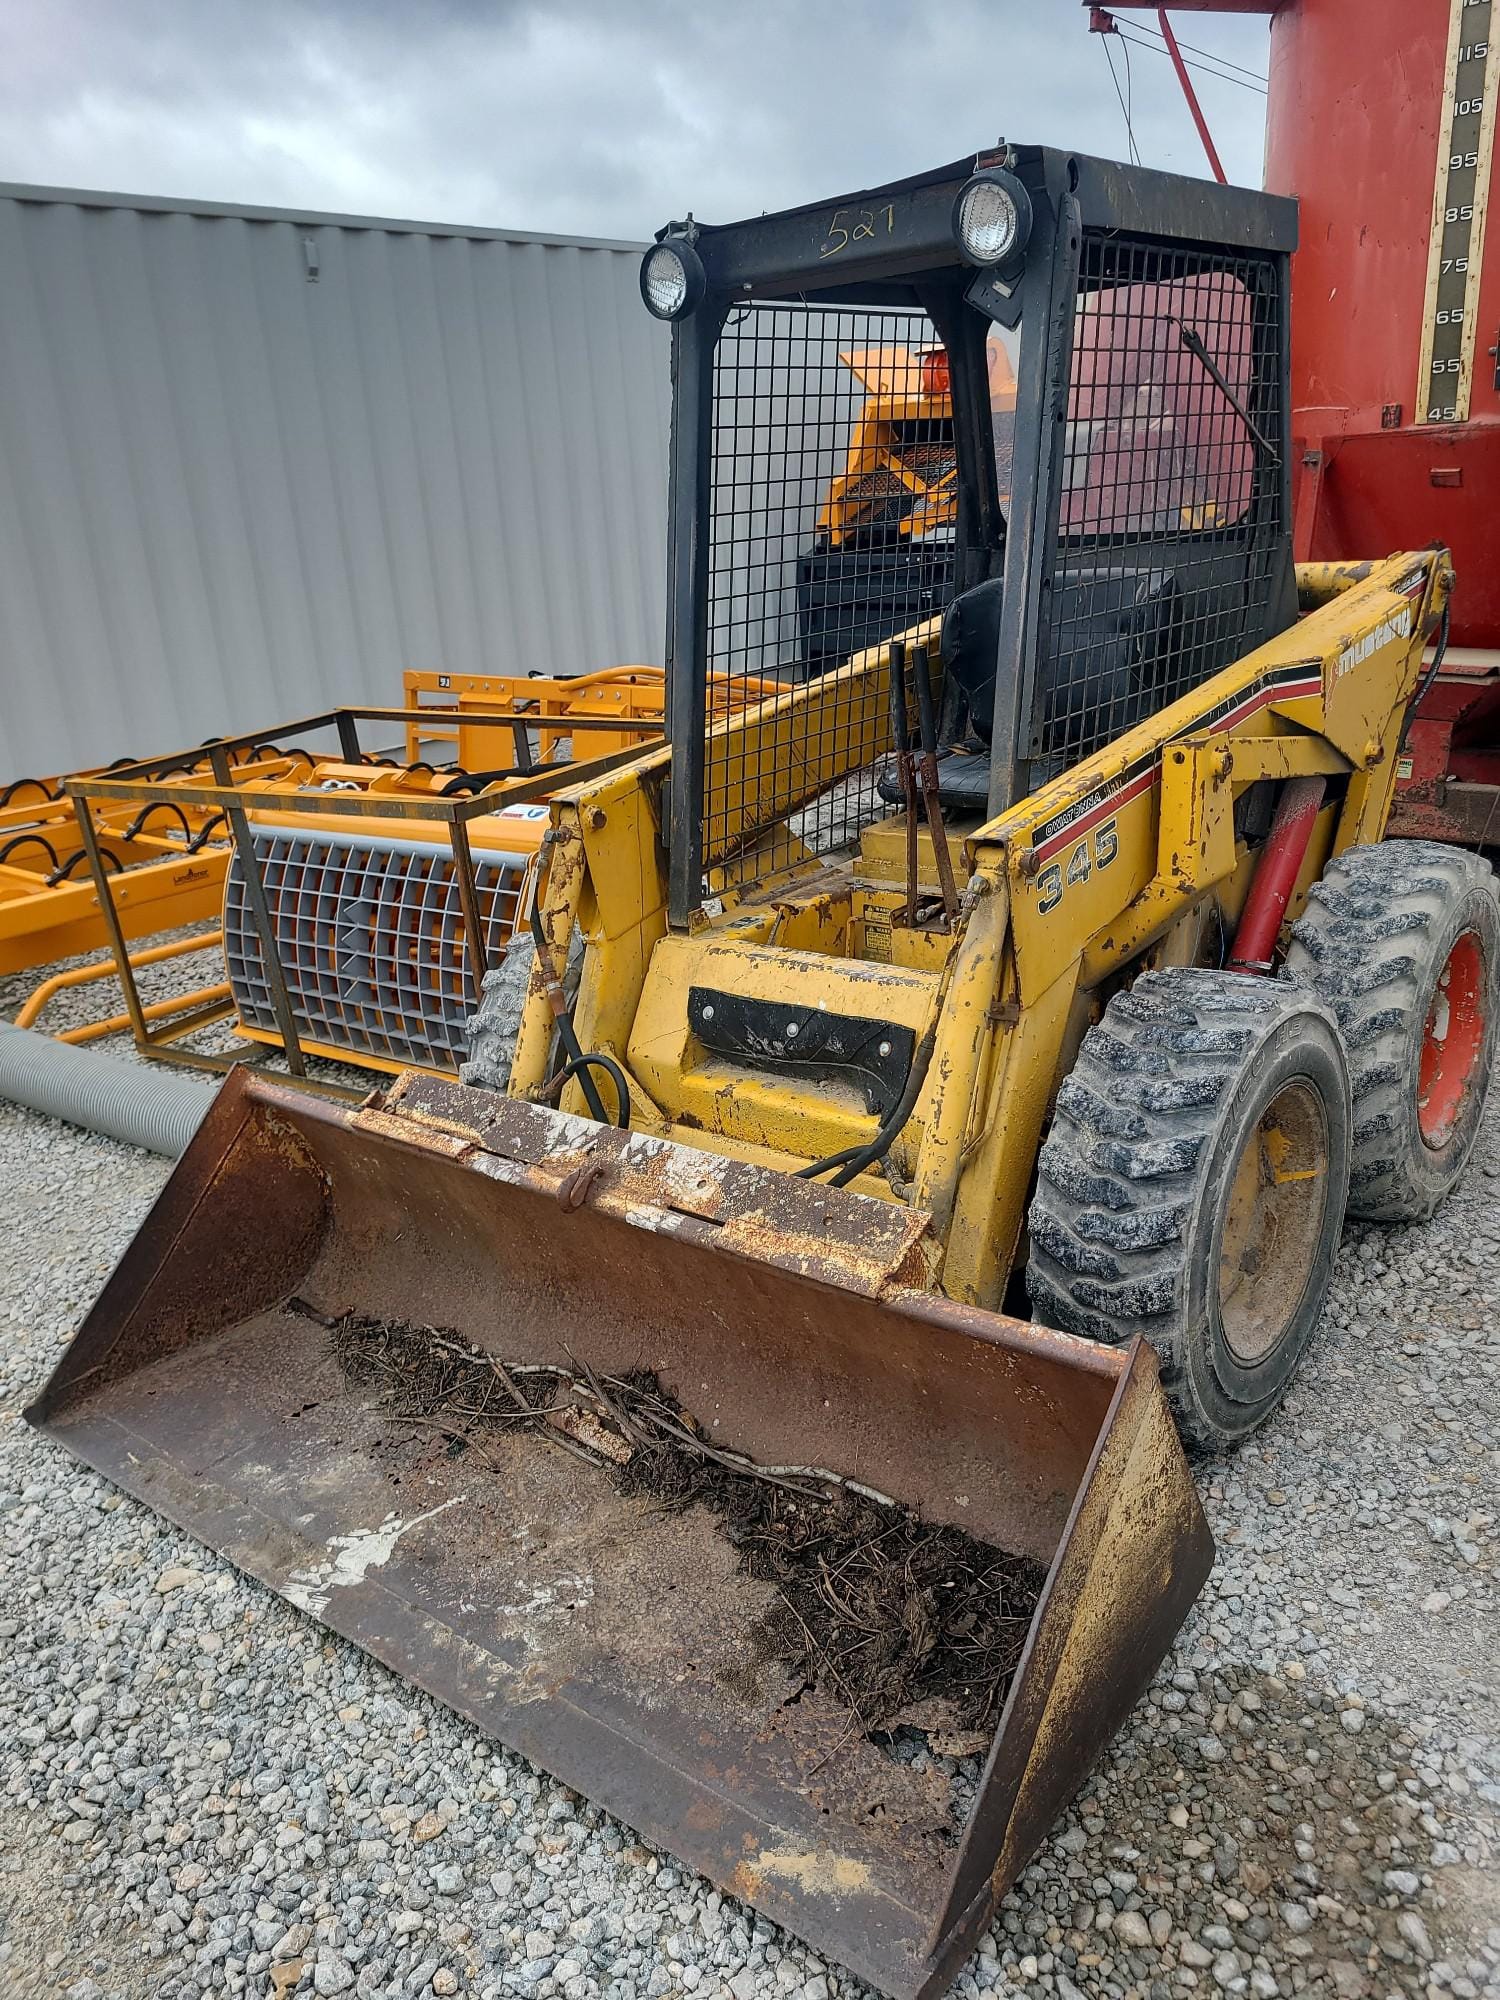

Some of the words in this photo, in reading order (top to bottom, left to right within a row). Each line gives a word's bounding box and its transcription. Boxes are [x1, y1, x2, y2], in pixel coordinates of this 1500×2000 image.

[1458, 42, 1489, 63] 115
[1453, 97, 1484, 117] 105
[1449, 151, 1479, 170] 95
[1444, 205, 1474, 223] 85
[1440, 257, 1470, 275] 75
[1436, 308, 1465, 325] 65
[1431, 358, 1460, 374] 55
[1428, 407, 1456, 421] 45
[1036, 816, 1120, 916] 345
